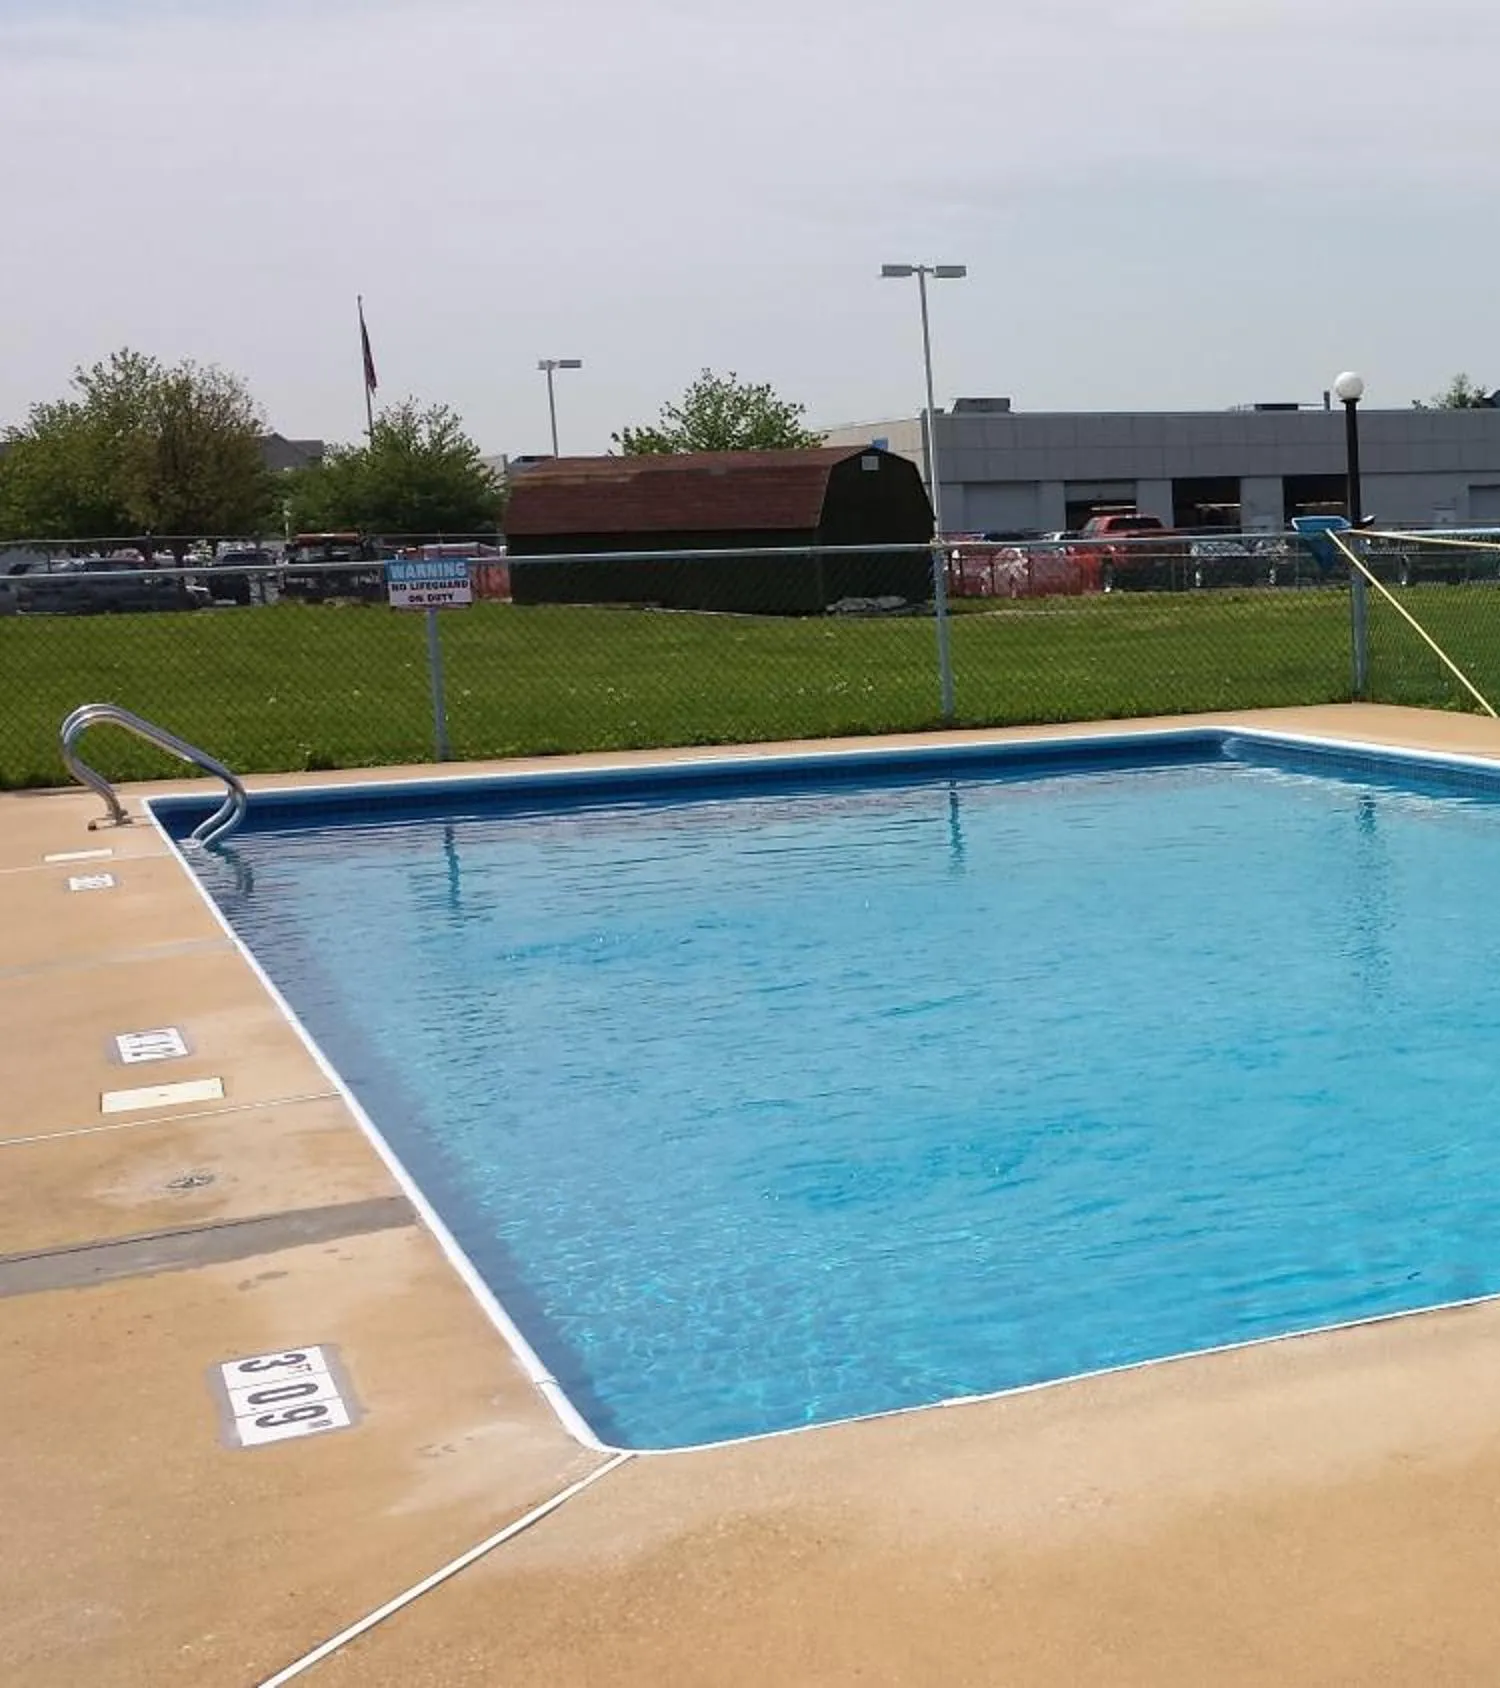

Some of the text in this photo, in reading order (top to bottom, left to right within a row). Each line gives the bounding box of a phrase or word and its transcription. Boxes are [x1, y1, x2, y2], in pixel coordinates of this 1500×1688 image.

[389, 561, 466, 579] WARNING
[391, 580, 469, 592] NO LIFEGUARD
[408, 593, 453, 603] ON DUTY
